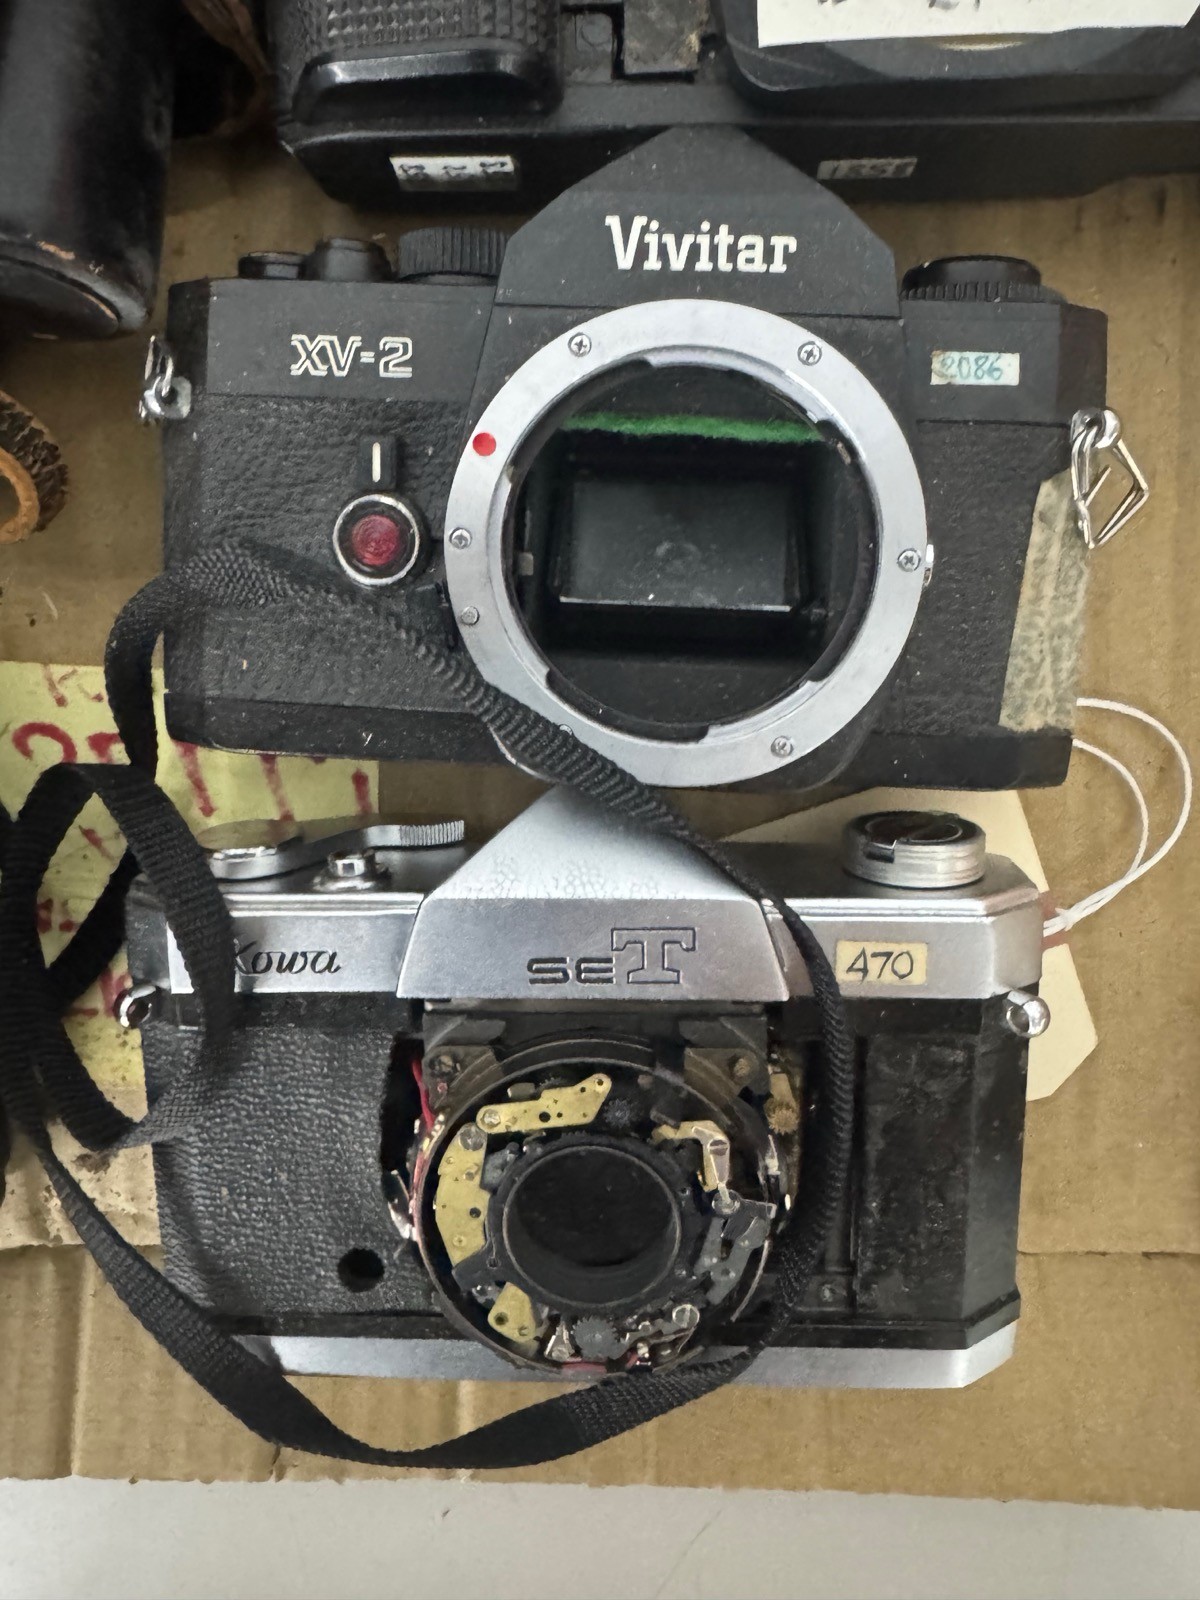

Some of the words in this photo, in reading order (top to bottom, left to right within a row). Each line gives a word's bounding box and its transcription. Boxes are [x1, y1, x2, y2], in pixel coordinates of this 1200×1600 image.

[605, 215, 797, 273] Vivitar
[291, 333, 413, 378] XV-2
[846, 946, 914, 982] 470
